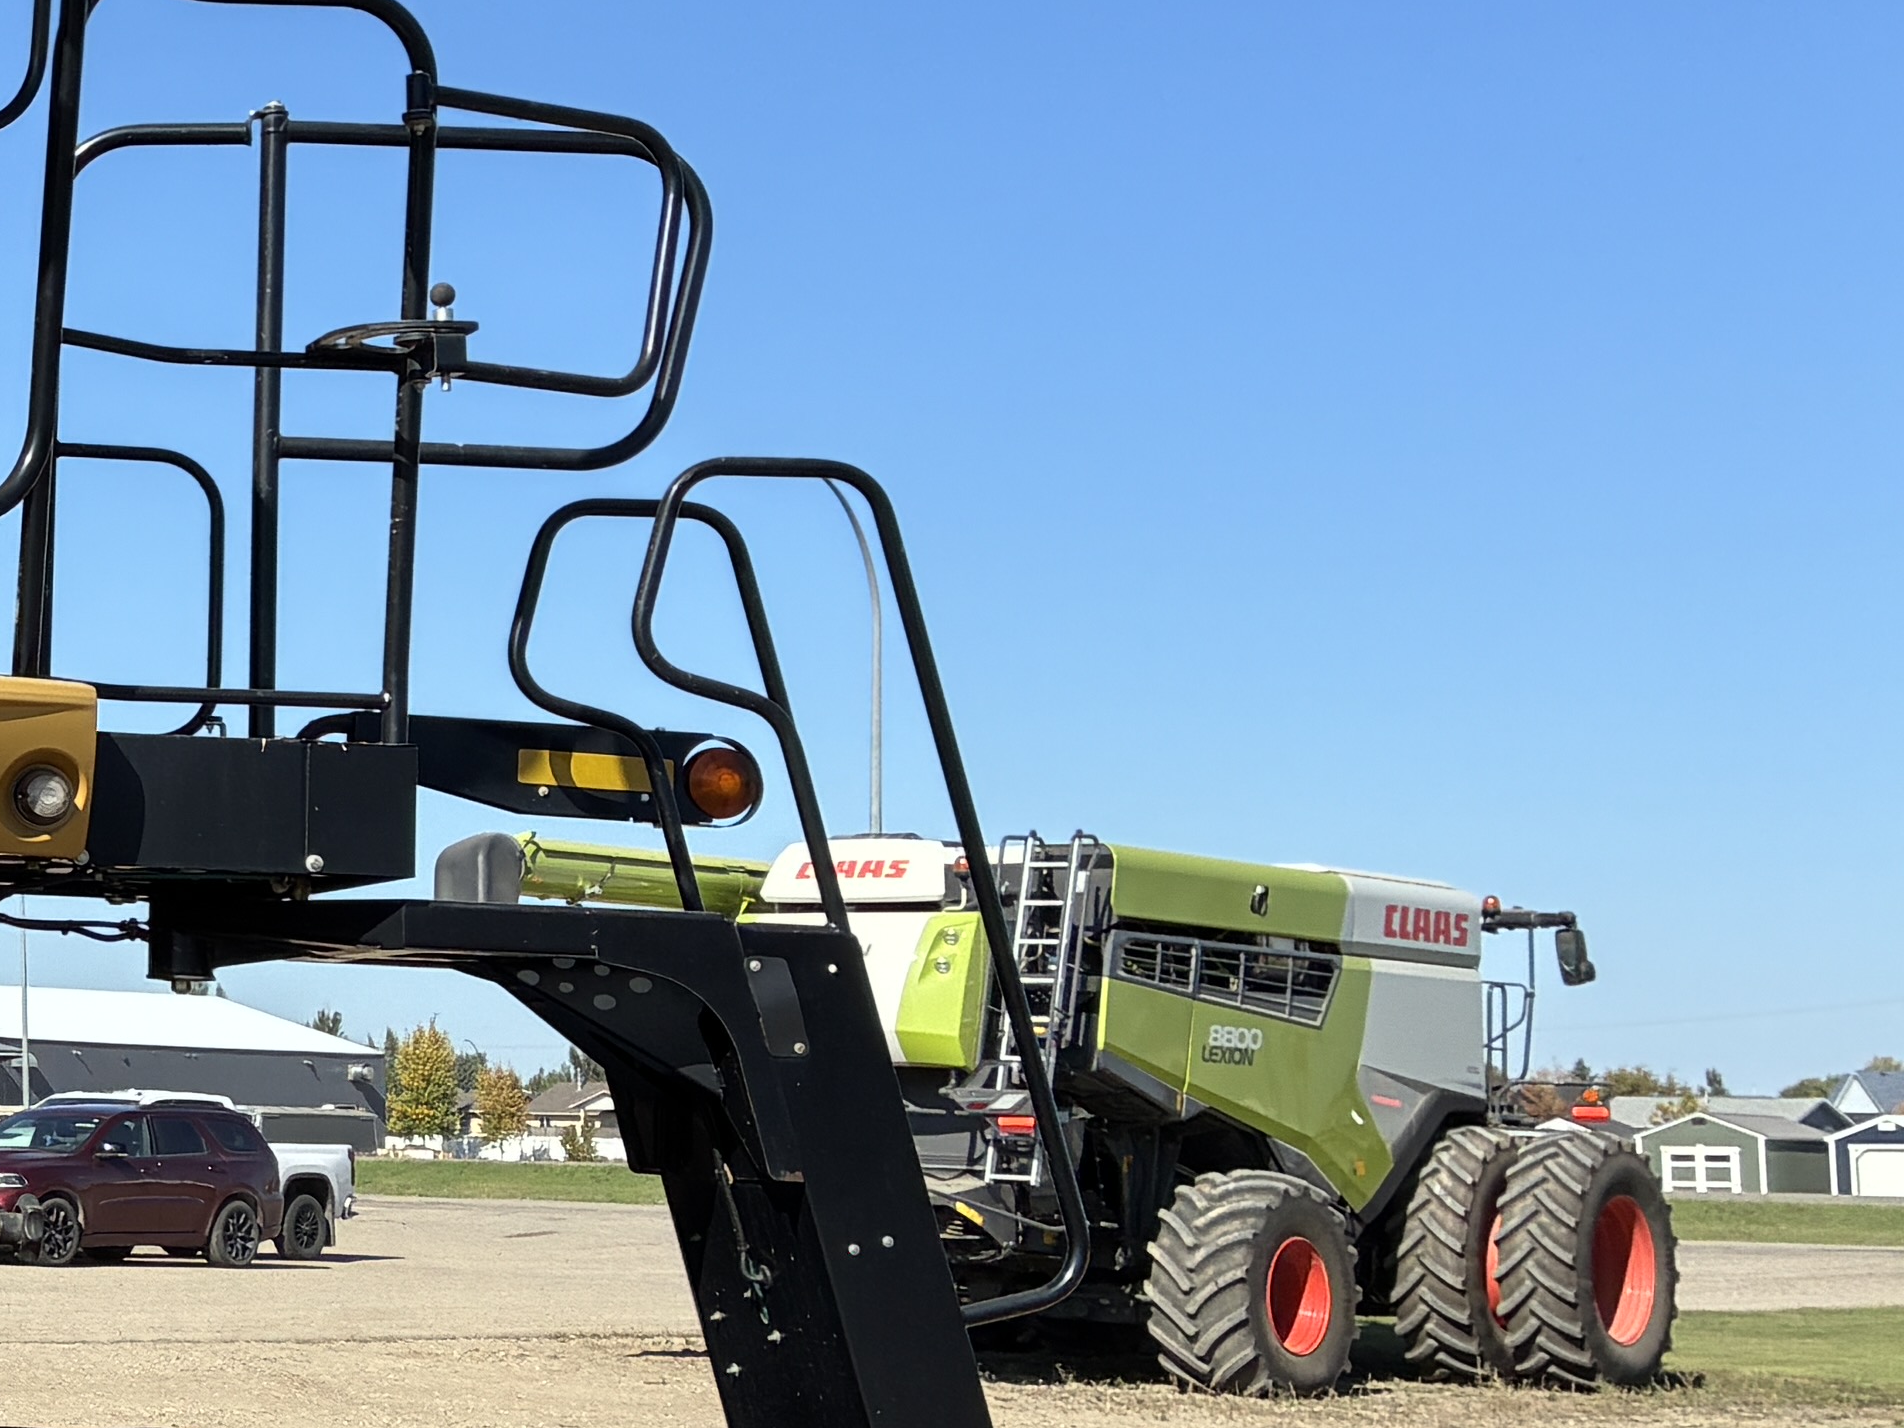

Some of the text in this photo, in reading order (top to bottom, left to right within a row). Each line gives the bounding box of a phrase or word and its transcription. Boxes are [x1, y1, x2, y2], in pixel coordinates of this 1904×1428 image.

[795, 860, 910, 879] CAAS
[1383, 904, 1469, 947] CLAAS
[1208, 1025, 1263, 1050] 8800
[1201, 1044, 1255, 1066] LEXION
